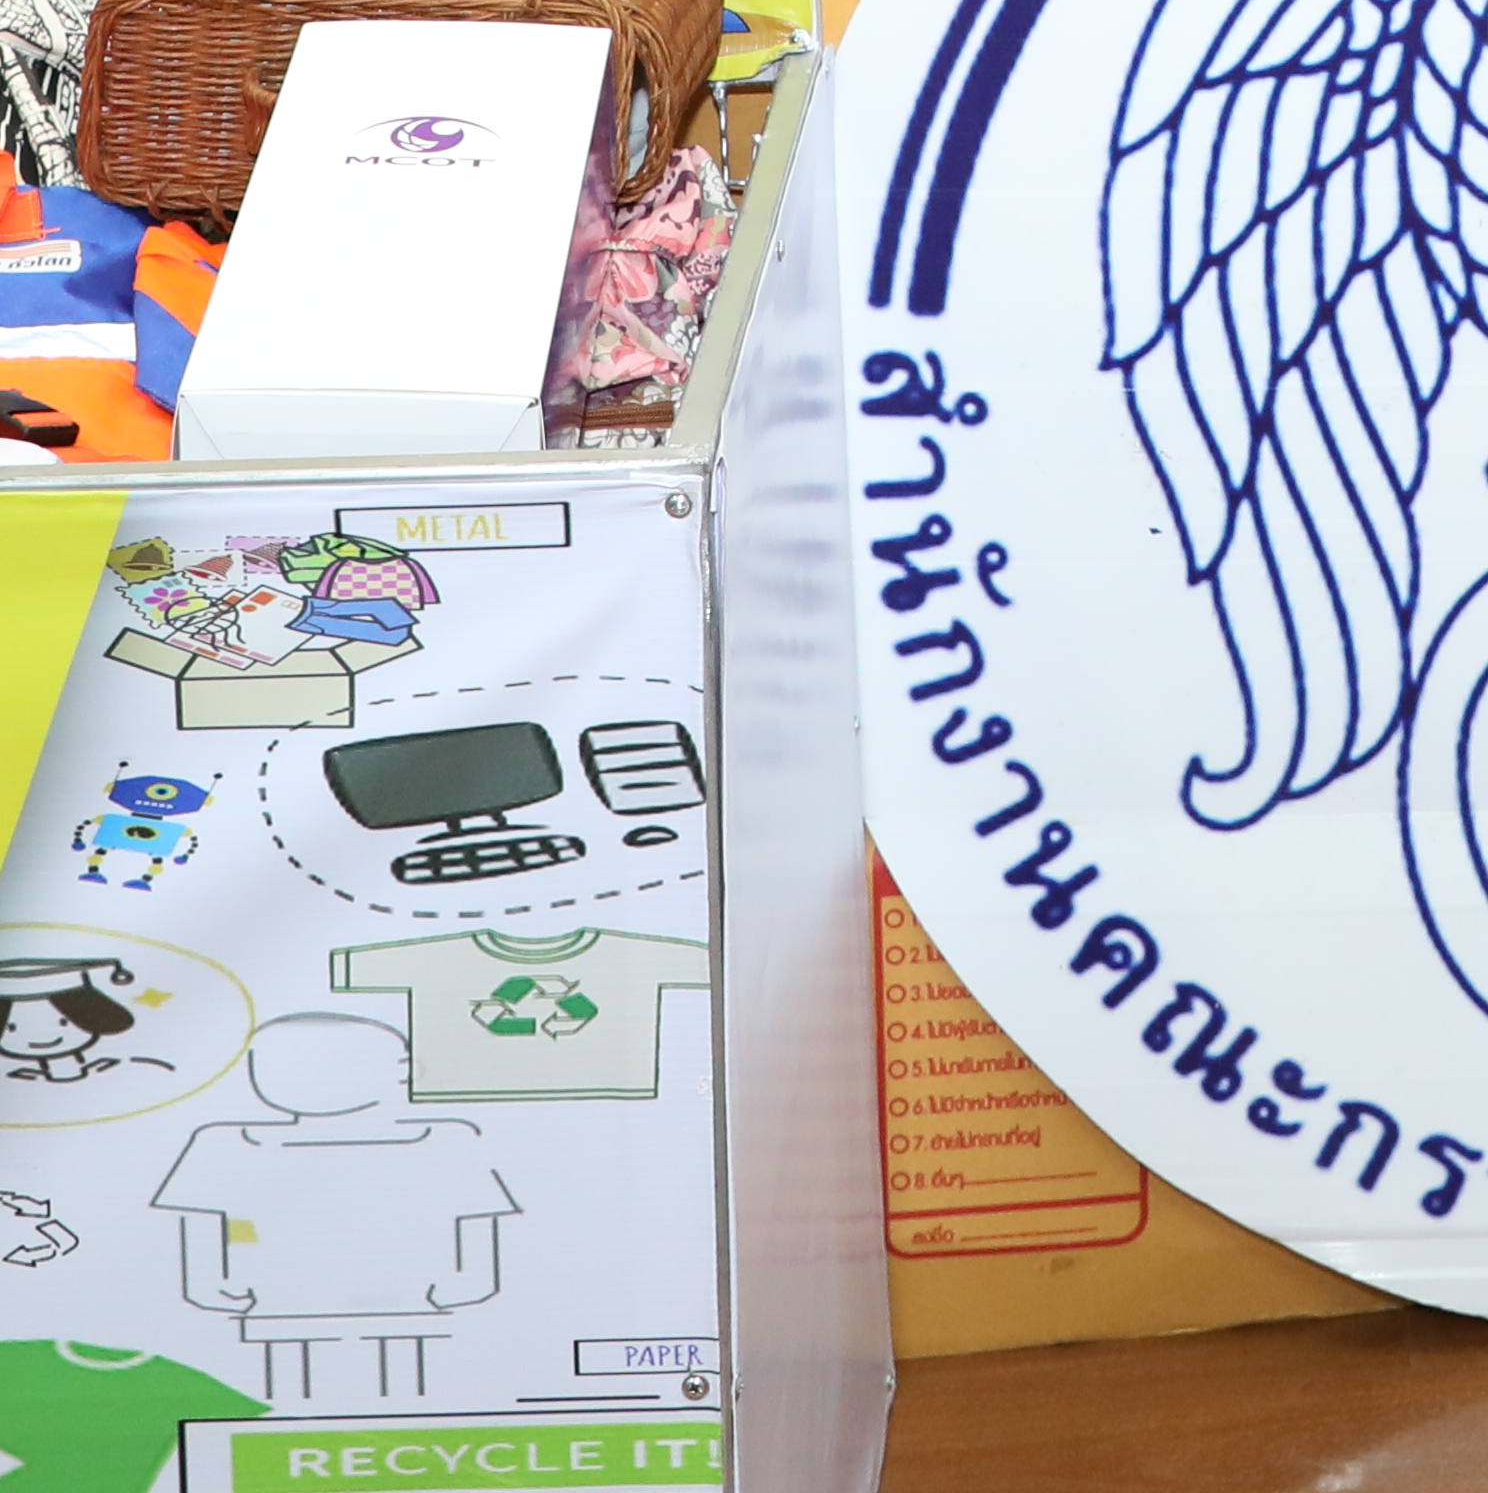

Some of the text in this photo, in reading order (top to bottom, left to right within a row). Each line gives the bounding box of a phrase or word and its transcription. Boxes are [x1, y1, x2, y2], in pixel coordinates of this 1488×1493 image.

[345, 156, 496, 167] MCOT
[396, 513, 510, 543] METAL
[625, 1344, 704, 1367] PAPER
[288, 1441, 604, 1479] RECYCLE
